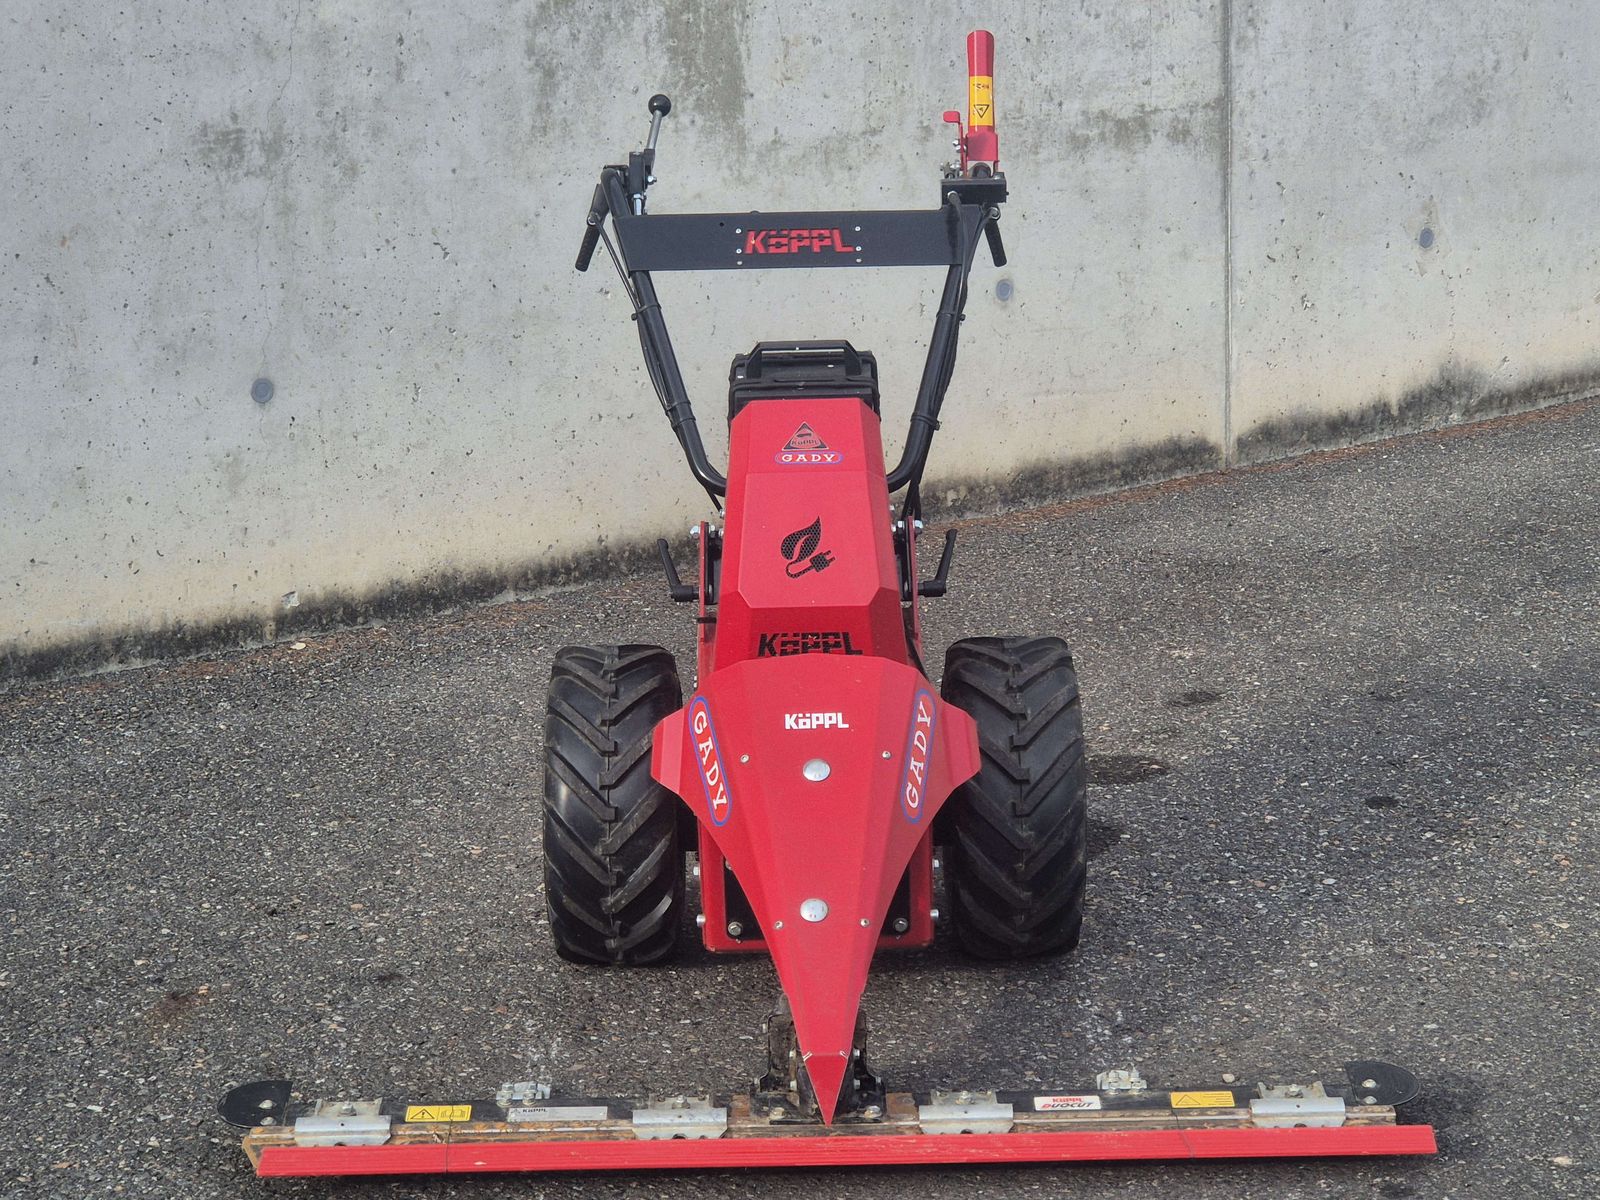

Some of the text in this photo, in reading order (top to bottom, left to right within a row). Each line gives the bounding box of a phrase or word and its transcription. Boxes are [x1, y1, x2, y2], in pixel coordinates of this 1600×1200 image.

[744, 228, 855, 254] KÖPPL
[782, 453, 836, 463] GADY
[757, 631, 863, 657] KÖPPL
[694, 710, 728, 811] GADY
[906, 700, 931, 809] GADY
